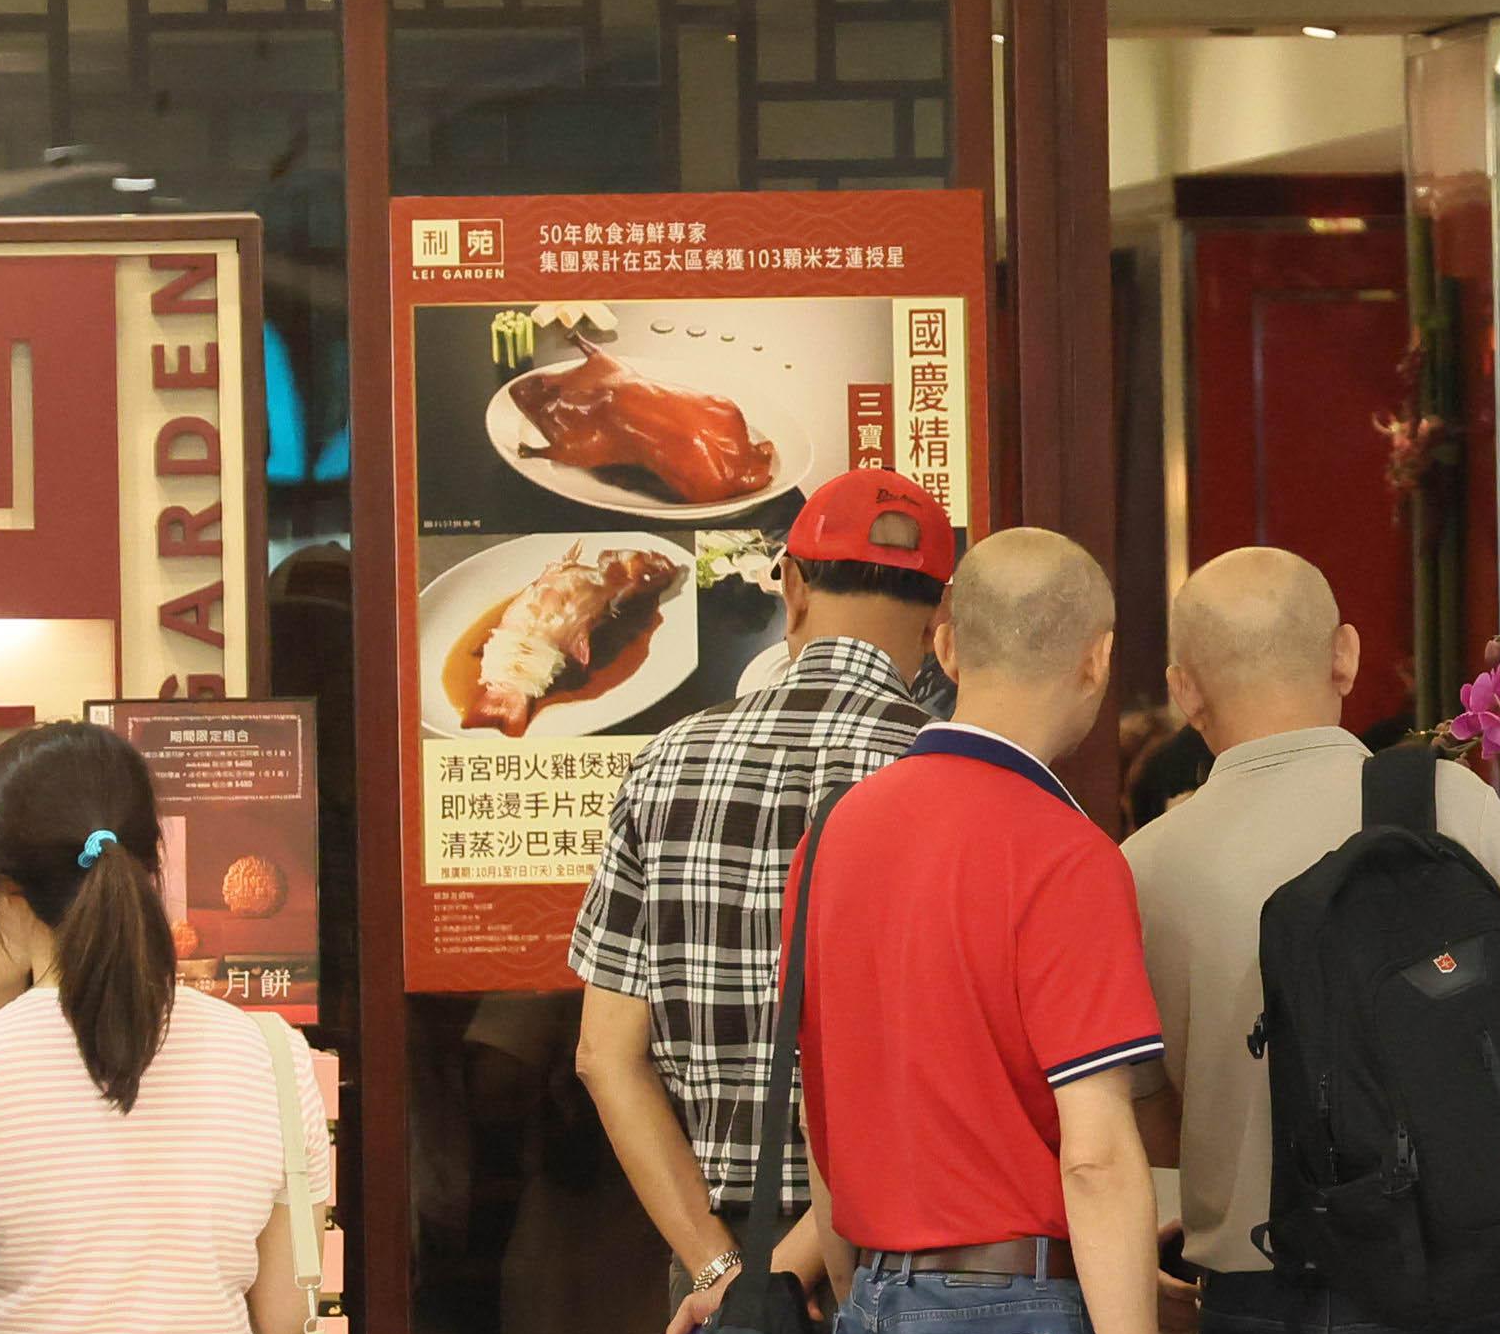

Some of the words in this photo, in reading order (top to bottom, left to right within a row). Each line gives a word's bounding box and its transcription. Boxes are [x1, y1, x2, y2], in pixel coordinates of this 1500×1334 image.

[421, 229, 495, 257] 利苑
[540, 221, 707, 245] 50年飲食海鮮專家
[539, 245, 906, 274] 集團累計在亞太區榮獲103顆米芝蓮授星
[412, 270, 435, 280] LEI
[442, 268, 505, 280] GARDEN
[222, 968, 292, 999] 月餅
